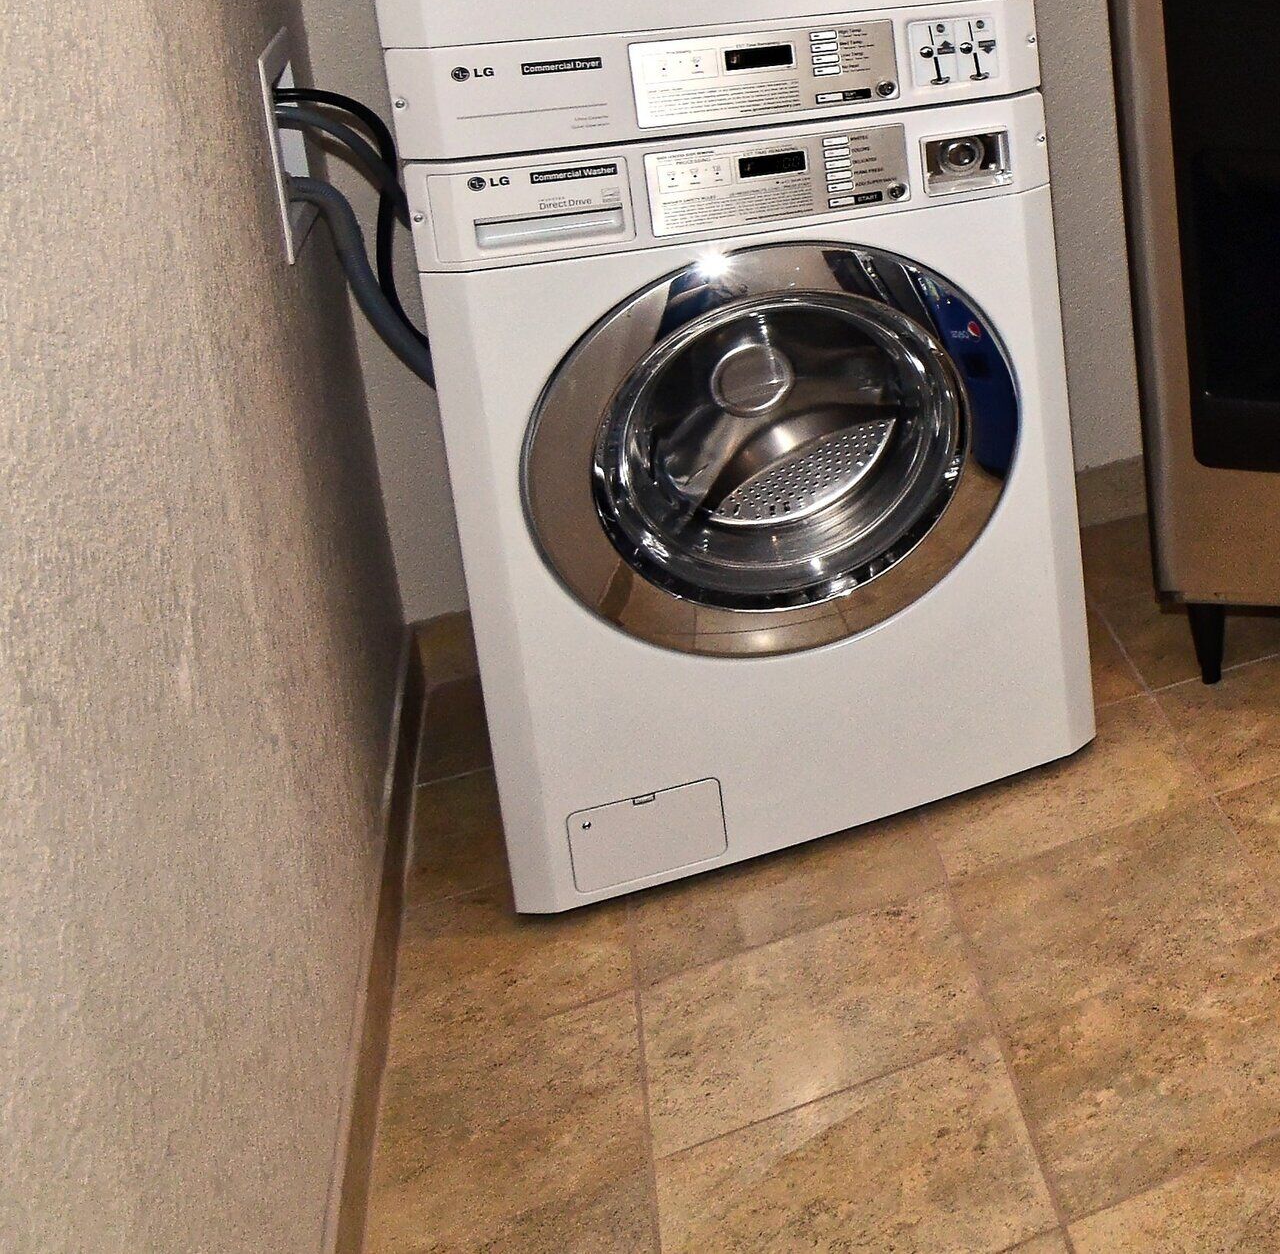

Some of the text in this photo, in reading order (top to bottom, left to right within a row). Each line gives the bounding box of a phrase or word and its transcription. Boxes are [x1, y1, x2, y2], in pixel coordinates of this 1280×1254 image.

[473, 59, 600, 78] LG Commercial Dryer
[490, 166, 615, 187] LG Commercial Washer
[539, 197, 592, 211] Direct Drive
